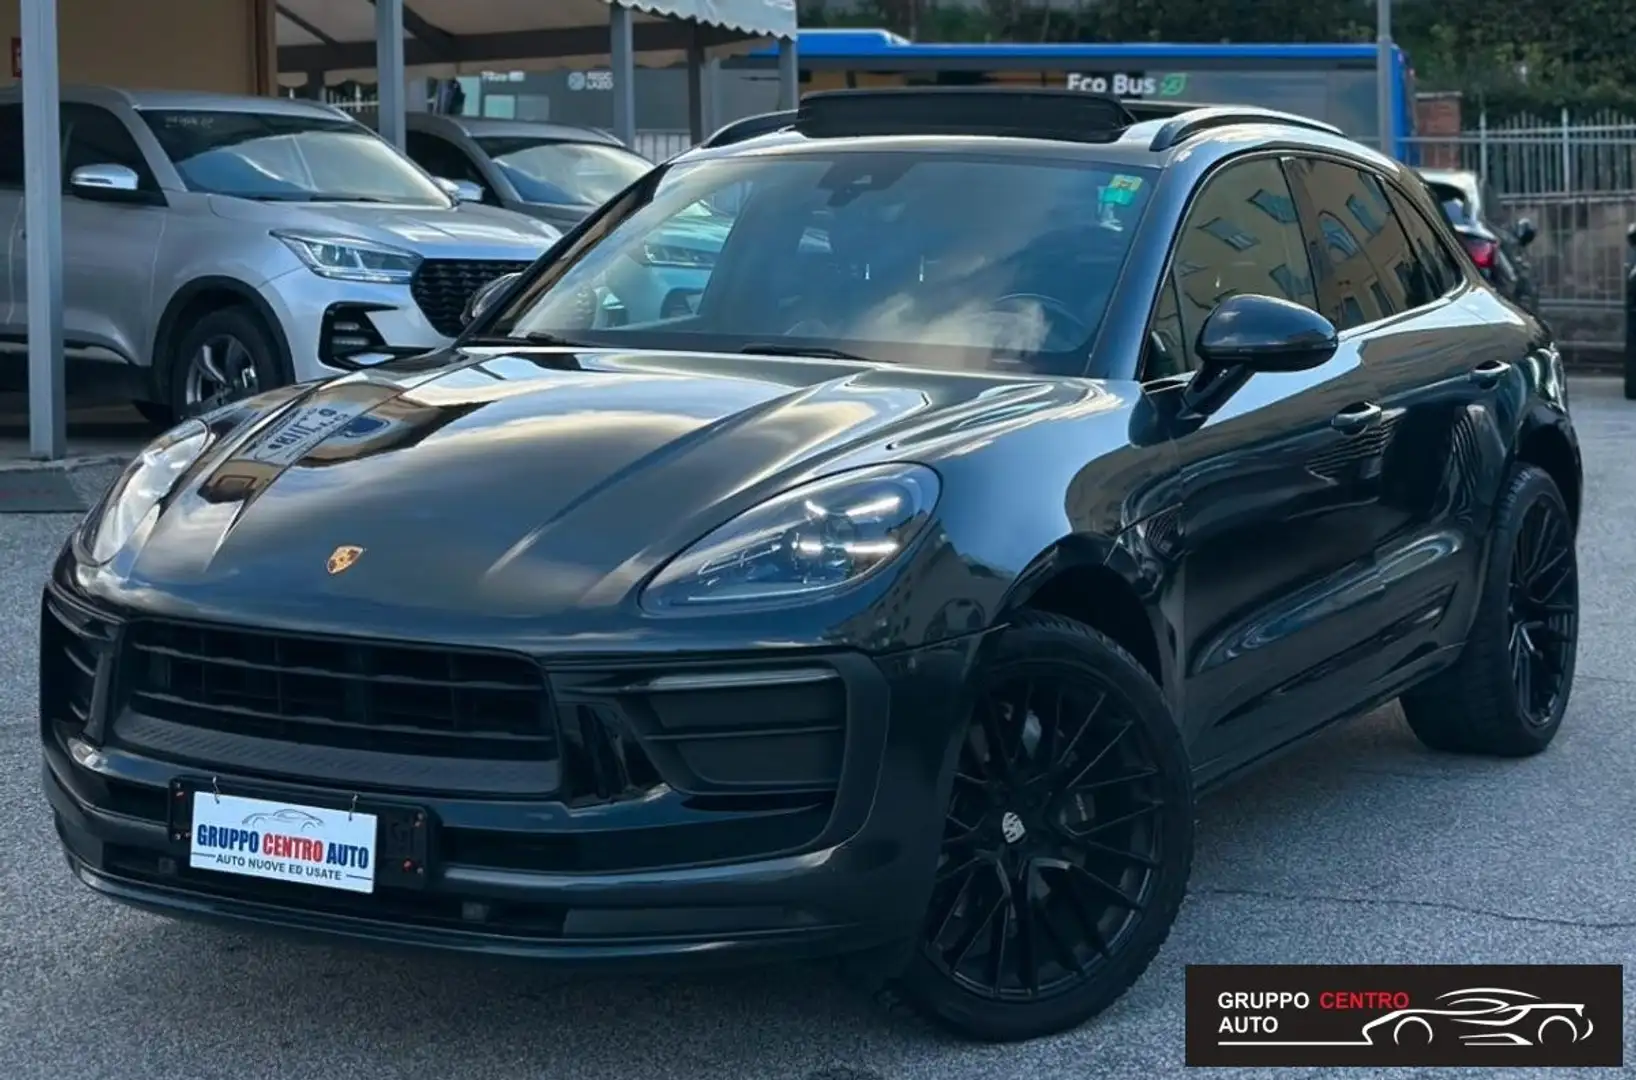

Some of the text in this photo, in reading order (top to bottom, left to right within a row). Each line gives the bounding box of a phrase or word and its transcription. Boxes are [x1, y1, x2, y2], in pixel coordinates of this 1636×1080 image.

[1113, 74, 1156, 94] Bus
[197, 824, 369, 870] GRUPPO CENTRO AUTO
[216, 854, 341, 881] AUTO NUOVE ED USATE
